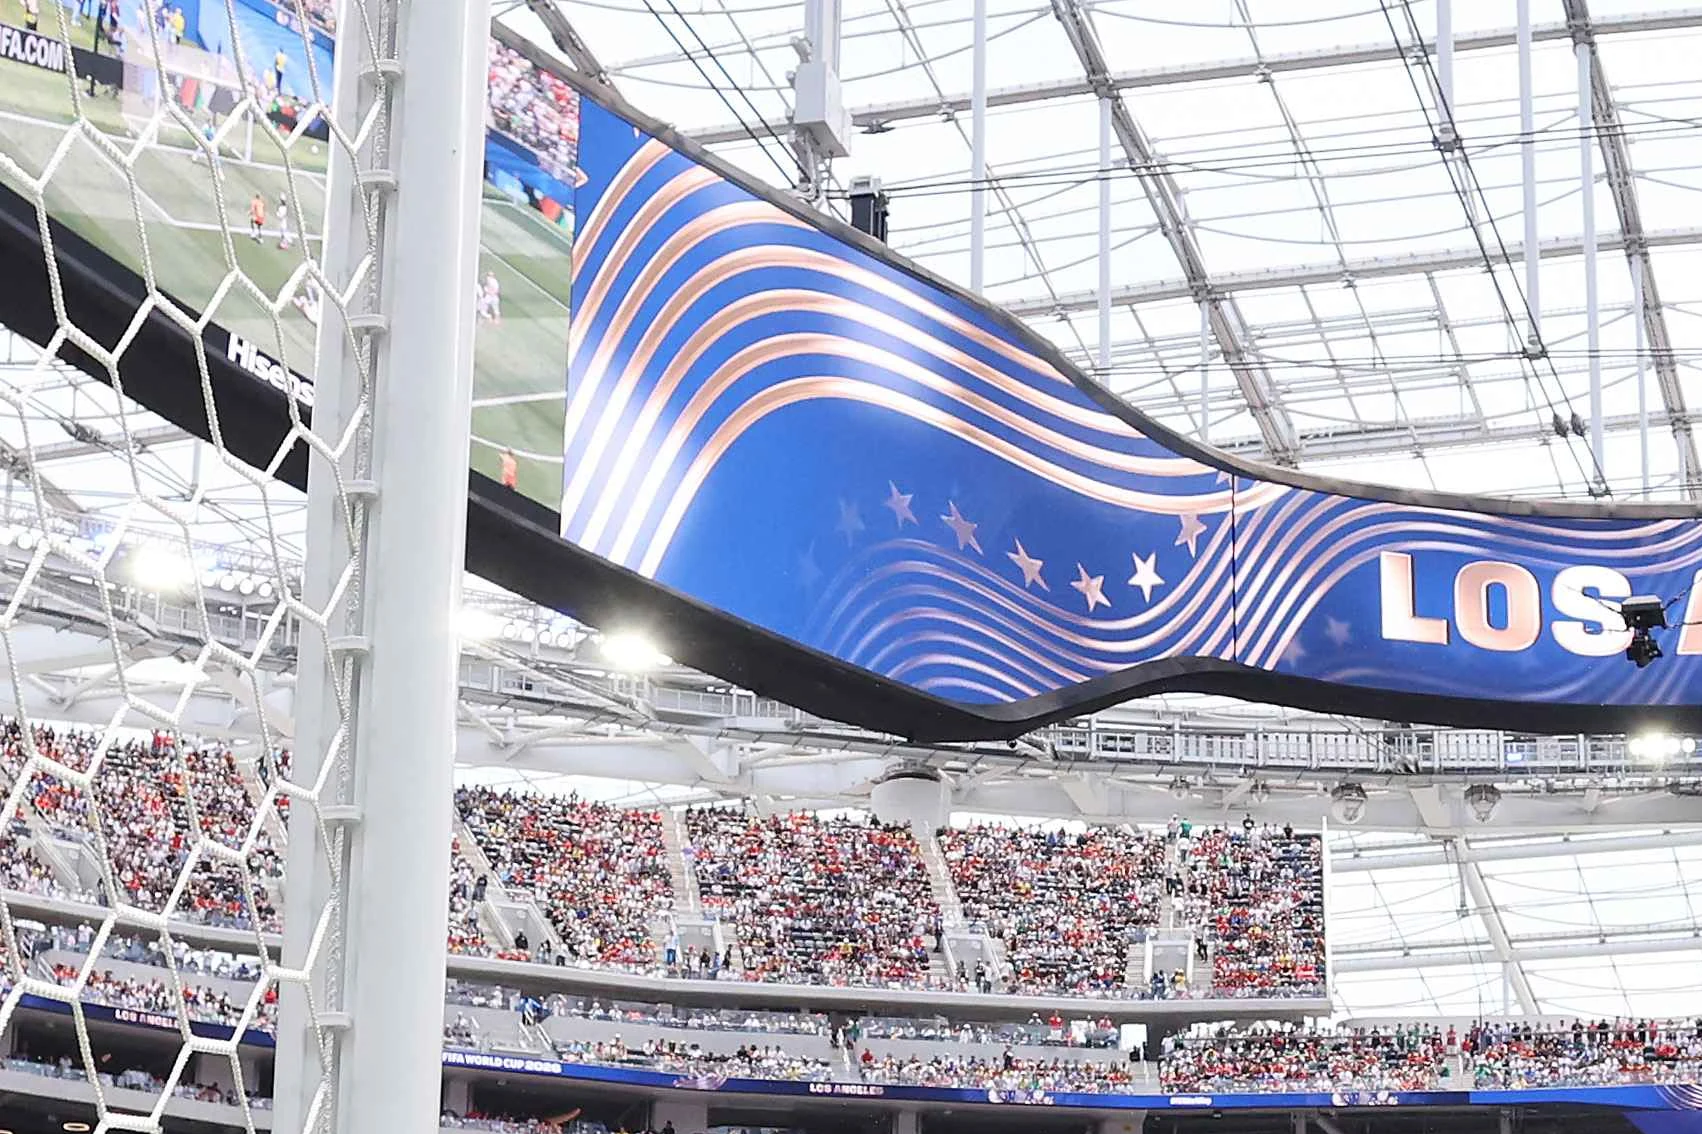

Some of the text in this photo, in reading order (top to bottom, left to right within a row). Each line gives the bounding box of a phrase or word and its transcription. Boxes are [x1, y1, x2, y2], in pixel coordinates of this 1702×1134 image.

[227, 332, 315, 407] Hisens
[1380, 549, 1632, 656] LOS
[503, 1058, 524, 1070] CUP
